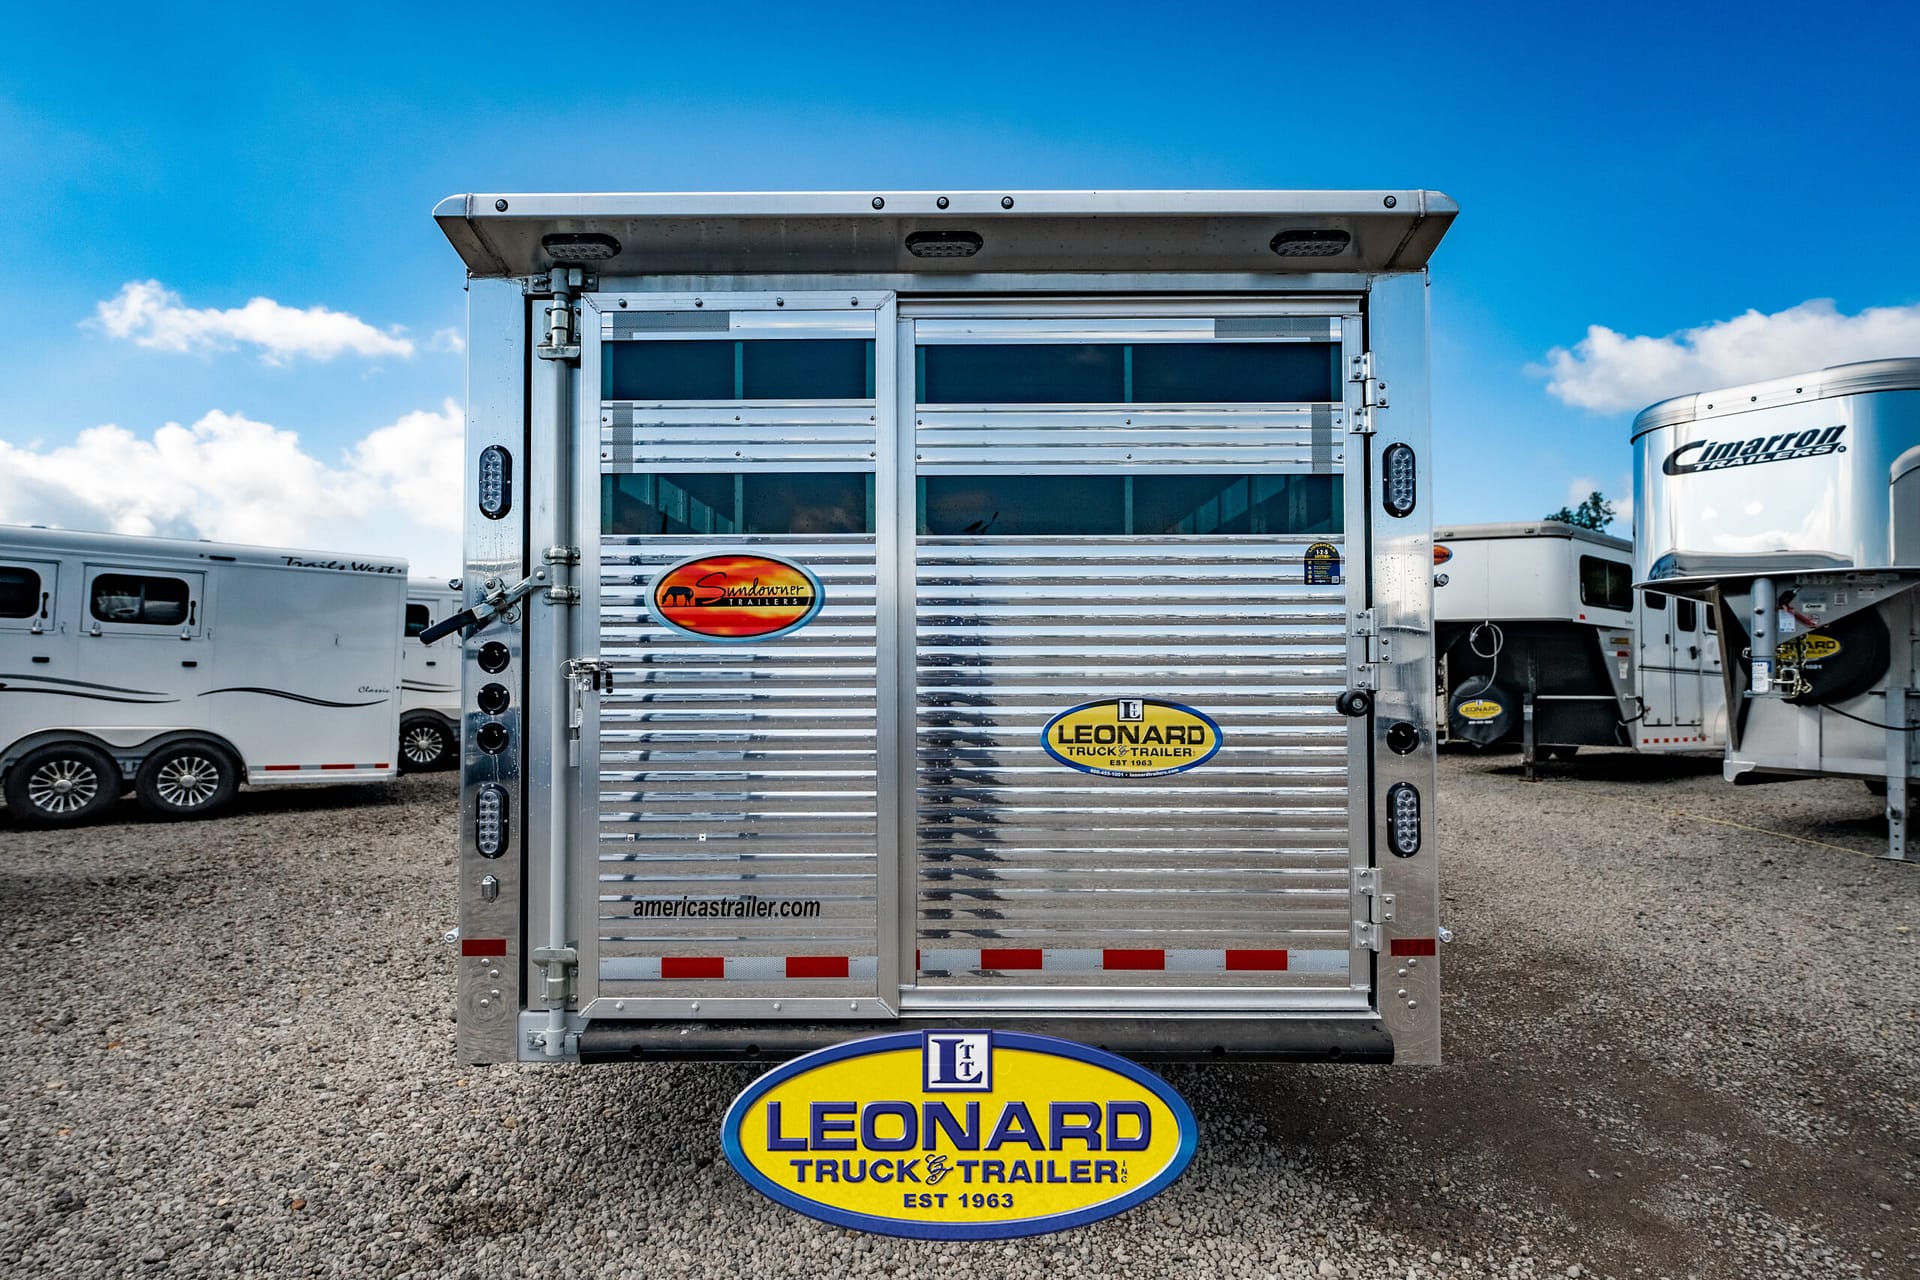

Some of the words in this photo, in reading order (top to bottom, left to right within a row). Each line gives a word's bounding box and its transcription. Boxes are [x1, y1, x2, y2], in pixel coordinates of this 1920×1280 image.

[1663, 425, 1847, 476] Cimarron
[1694, 444, 1834, 471] TRAILERS
[280, 556, 346, 571] Trails
[351, 562, 396, 574] West
[695, 571, 805, 605] Sundowner
[729, 597, 798, 606] TRAILERS
[1057, 725, 1206, 745] LEONARD
[1067, 746, 1117, 757] TRUCK
[1132, 747, 1193, 757] TRAILER
[633, 895, 821, 917] americastrailer.com
